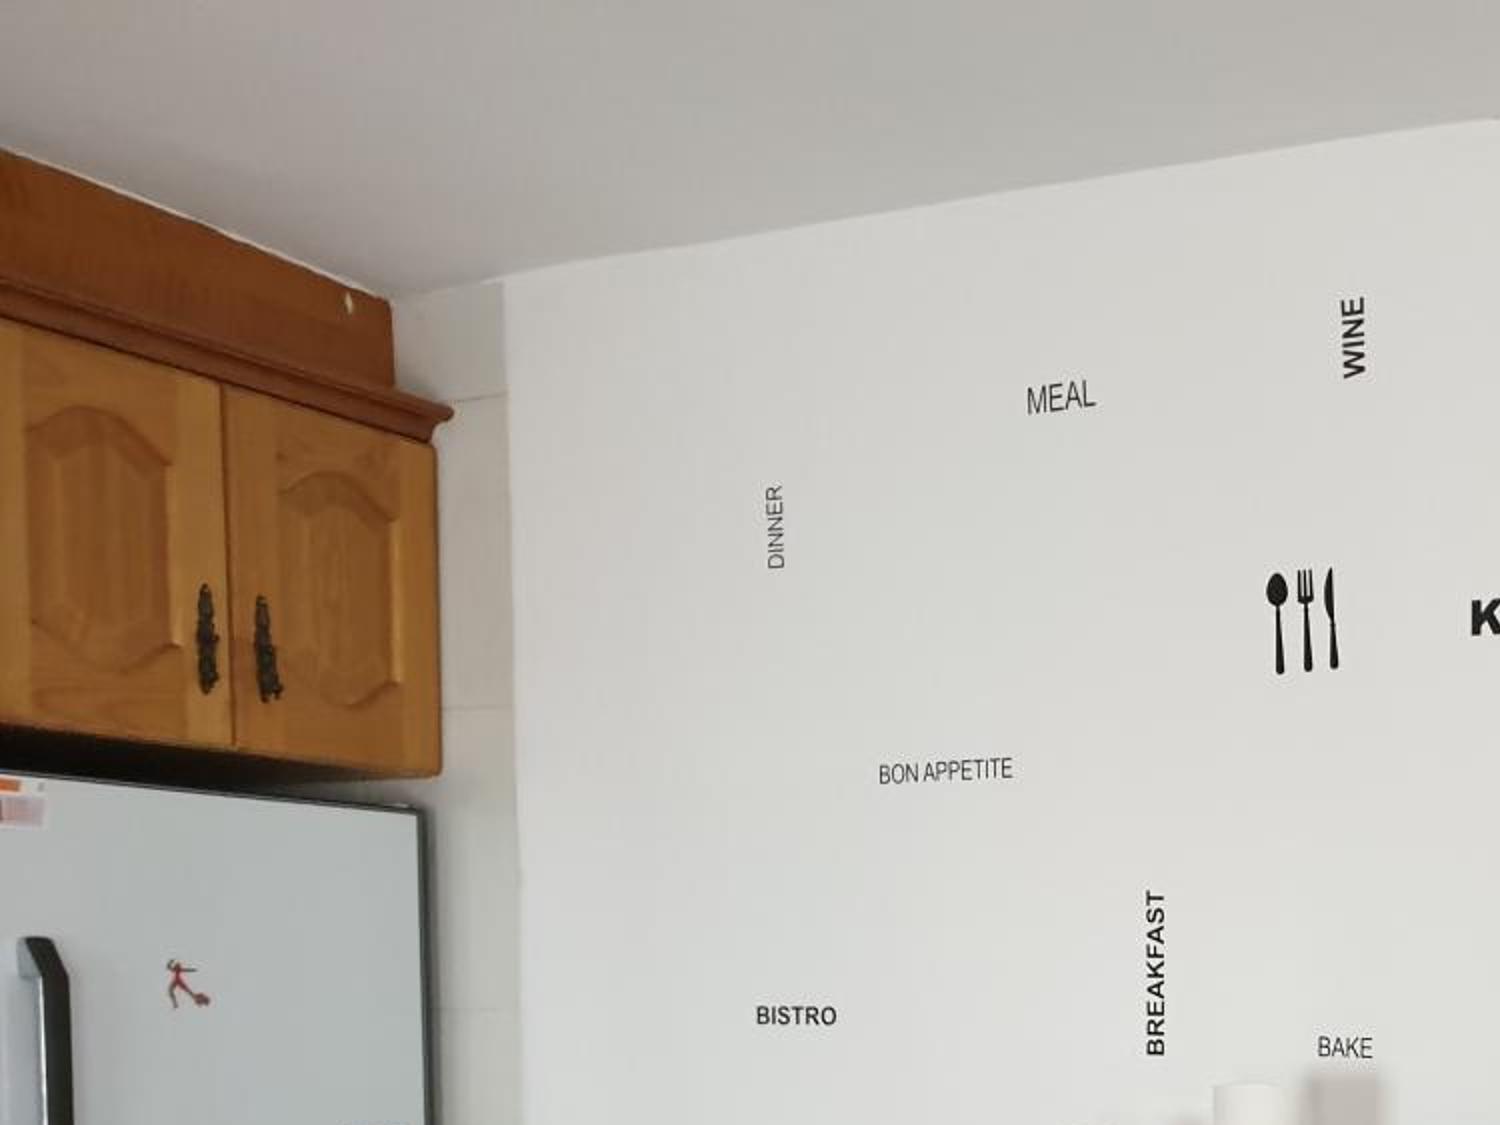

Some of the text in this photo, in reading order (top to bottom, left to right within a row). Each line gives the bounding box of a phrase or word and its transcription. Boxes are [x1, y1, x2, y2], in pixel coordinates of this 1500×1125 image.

[1340, 296, 1366, 379] WINE
[1027, 379, 1097, 415] MEAL
[765, 485, 785, 569] DINNER
[879, 757, 1013, 785] BON APPETITE
[1145, 890, 1165, 1056] BREAKFAST
[756, 1005, 837, 1026] BISTRO
[1318, 1035, 1373, 1059] BAKE
